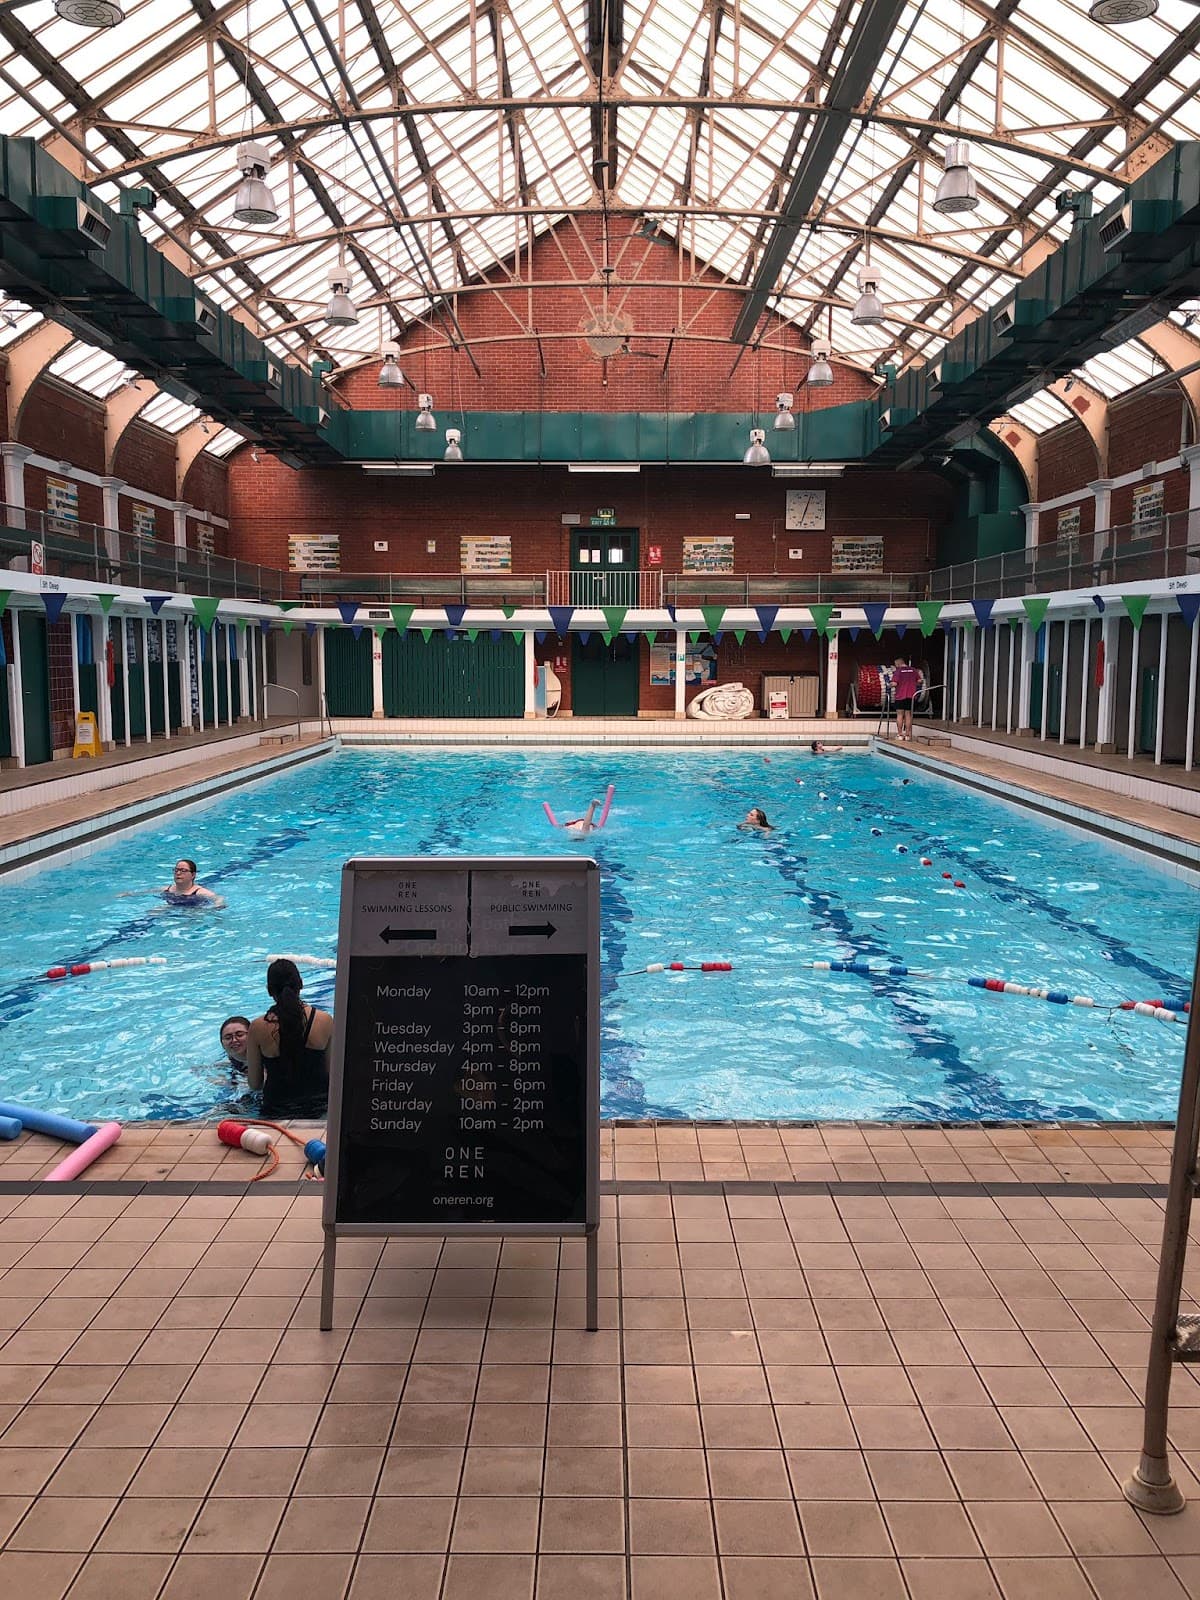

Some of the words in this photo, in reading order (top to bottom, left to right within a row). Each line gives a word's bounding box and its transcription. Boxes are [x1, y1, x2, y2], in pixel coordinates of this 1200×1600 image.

[398, 881, 417, 889] ONE
[522, 881, 541, 889] ONE
[398, 890, 417, 898] REN
[522, 889, 541, 898] REN
[361, 904, 413, 913] SWIMMING
[415, 904, 453, 913] LESSONS
[490, 904, 521, 913] PUBLIC
[522, 903, 573, 912] SWIMMING
[376, 985, 432, 1000] Monday
[463, 984, 499, 997] 10am
[515, 984, 550, 999] 12pm
[463, 1003, 494, 1018] 3pm
[510, 1002, 541, 1018] 8pm
[375, 1022, 432, 1037] Tuesday
[462, 1021, 494, 1037] 3pm
[510, 1021, 541, 1037] 8pm
[374, 1041, 455, 1056] Wednesday
[462, 1040, 493, 1055] 4pm
[509, 1040, 541, 1055] 8pm
[373, 1060, 437, 1075] Thursday
[461, 1059, 493, 1075] 4pm
[509, 1059, 541, 1075] 8pm
[372, 1079, 414, 1094] Friday
[460, 1078, 497, 1091] 10am
[513, 1078, 546, 1093] 6pm
[371, 1098, 433, 1113] Saturday
[460, 1098, 497, 1110] 10am
[513, 1097, 544, 1113] 2pm
[370, 1117, 422, 1133] Sunday
[459, 1117, 496, 1129] 10am
[512, 1116, 544, 1132] 2pm
[445, 1146, 485, 1160] ONE
[444, 1165, 484, 1178] REN
[432, 1196, 494, 1208] oneren.org
